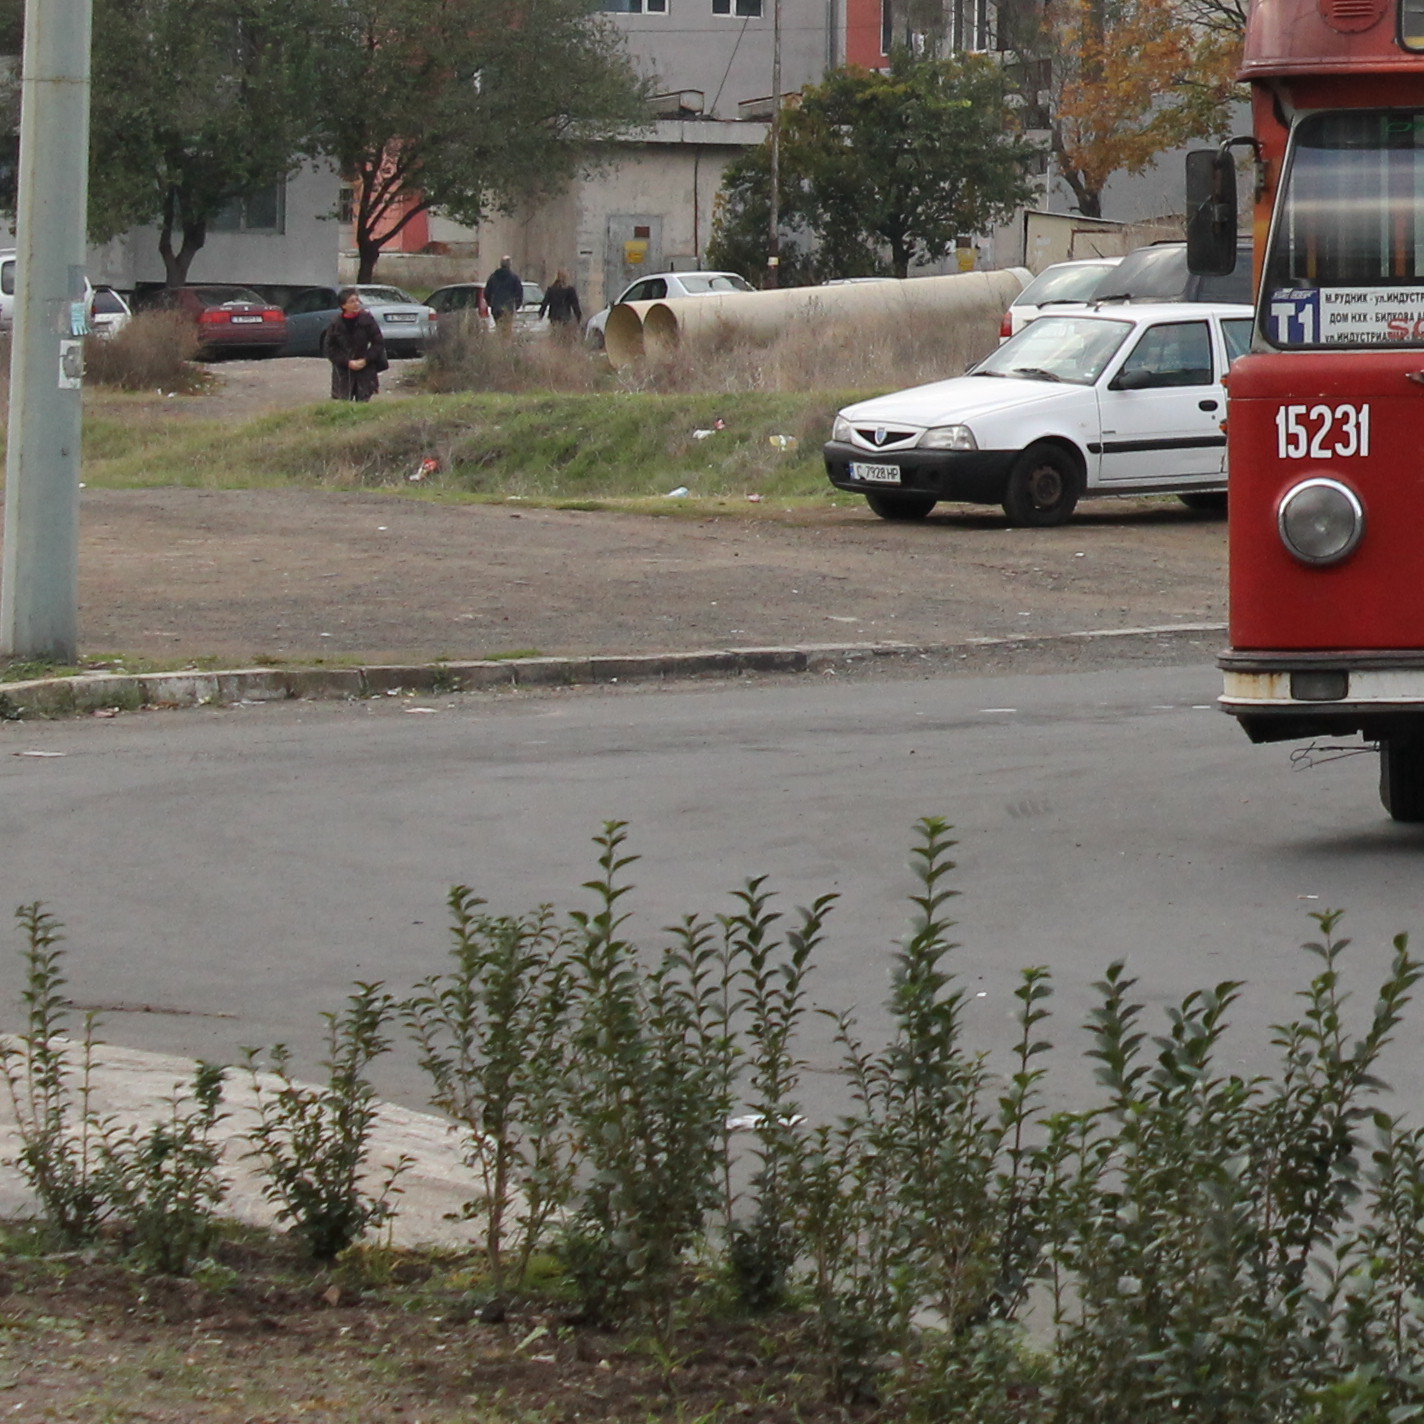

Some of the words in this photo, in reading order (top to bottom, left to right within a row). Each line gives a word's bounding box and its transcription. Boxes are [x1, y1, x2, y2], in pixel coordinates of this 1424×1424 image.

[1271, 302, 1314, 344] T1
[1329, 313, 1349, 324] ДОМ
[1275, 403, 1370, 459] 15231
